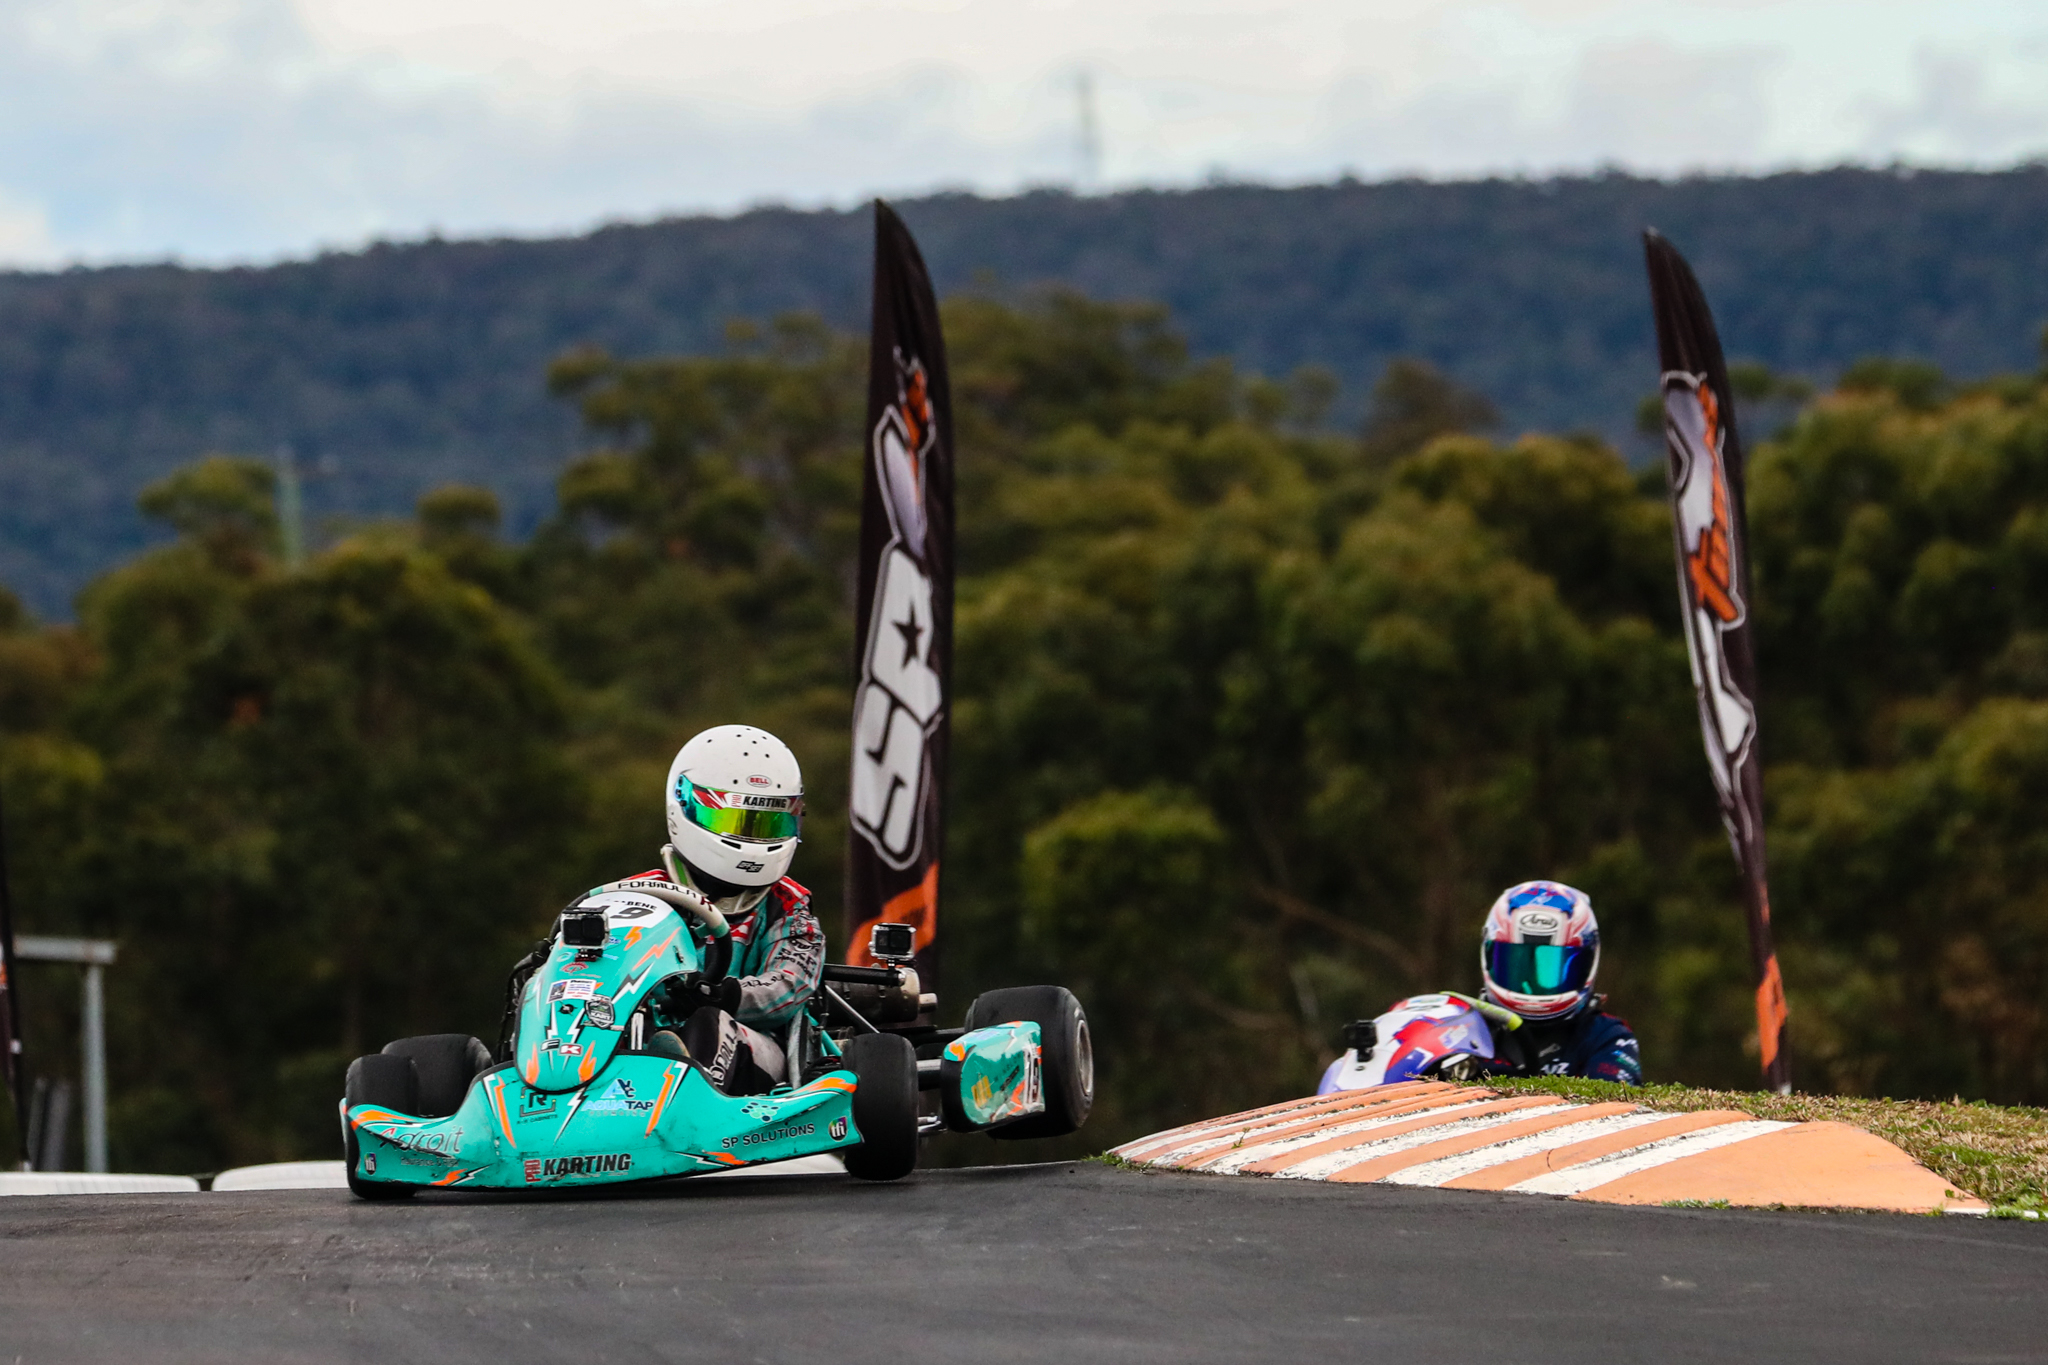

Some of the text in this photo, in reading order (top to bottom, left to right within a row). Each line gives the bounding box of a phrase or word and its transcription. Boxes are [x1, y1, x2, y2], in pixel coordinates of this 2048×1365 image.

[749, 777, 769, 785] BELL
[742, 796, 787, 808] KARTING
[626, 900, 657, 911] BENE
[722, 1123, 815, 1149] SP SOLUTIONS
[524, 1153, 632, 1182] PRO KARTING
